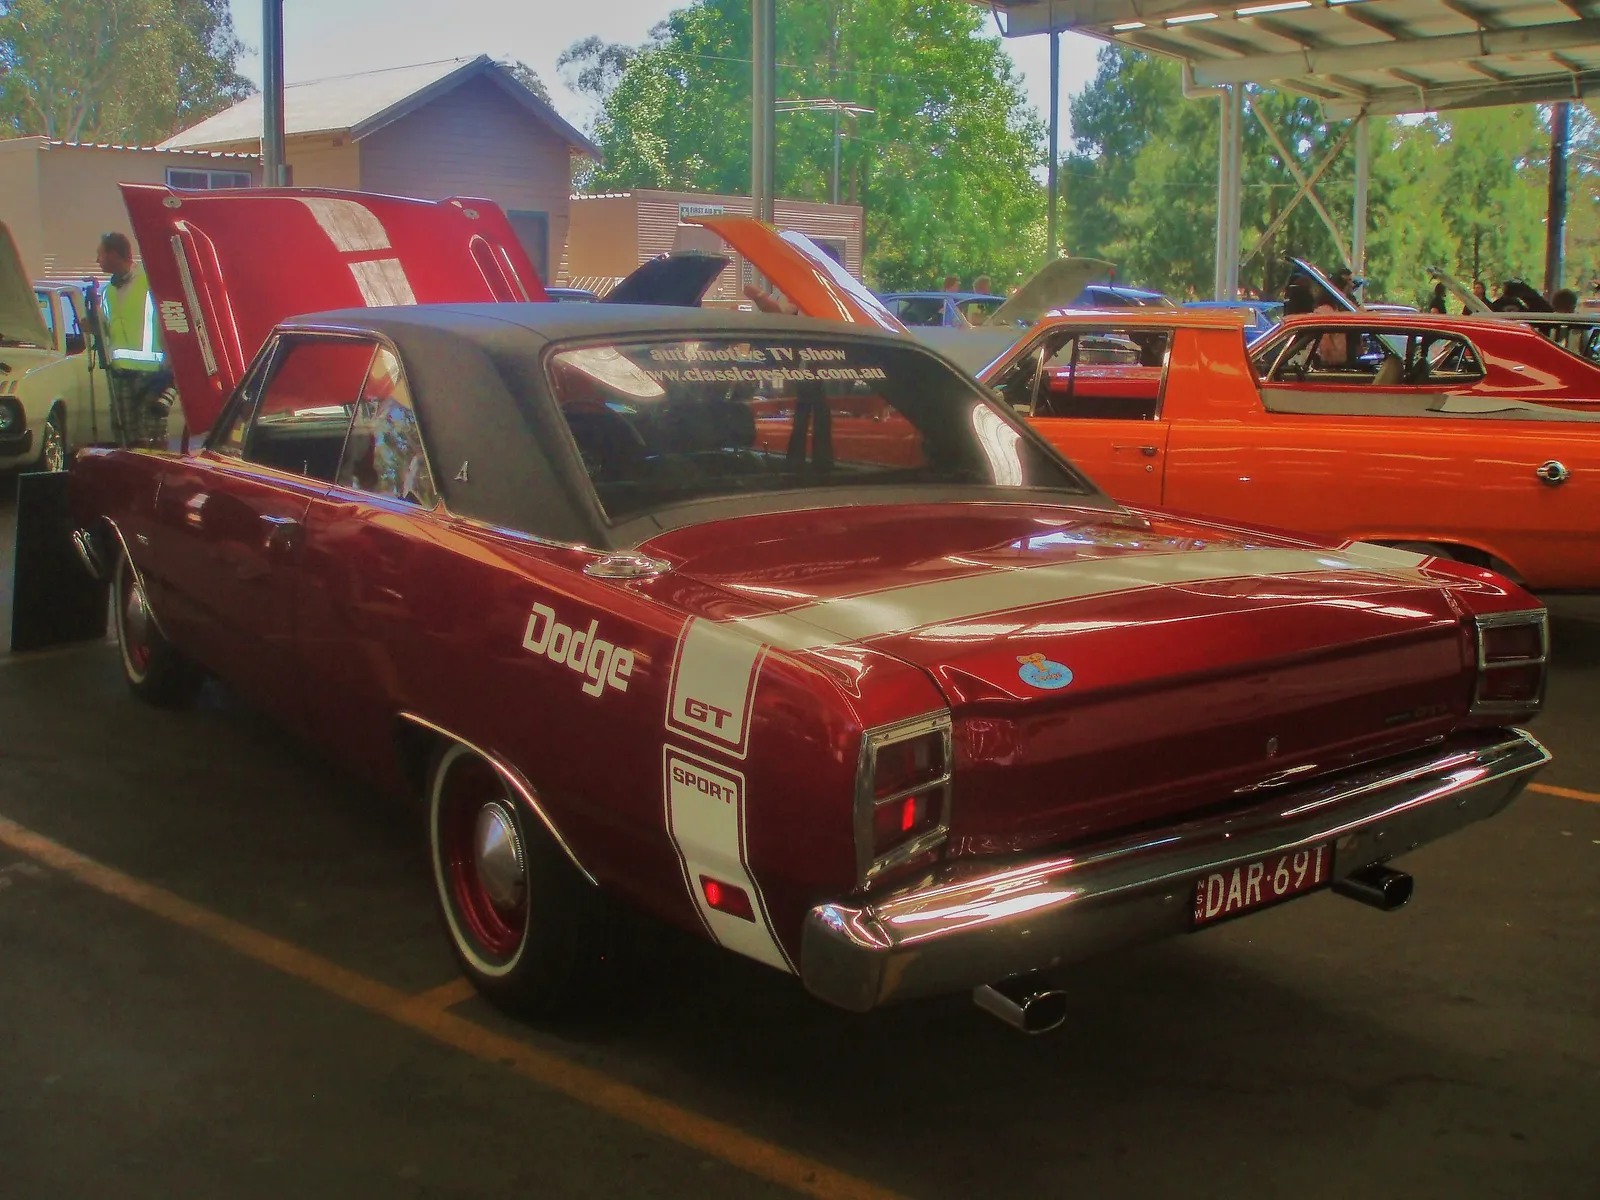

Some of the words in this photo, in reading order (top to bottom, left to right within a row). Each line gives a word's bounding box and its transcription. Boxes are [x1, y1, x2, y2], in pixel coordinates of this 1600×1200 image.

[690, 206, 704, 214] FIRST
[704, 207, 713, 215] AID
[766, 347, 796, 361] TV
[799, 347, 846, 361] show
[522, 601, 635, 698] Dodge
[684, 697, 732, 729] GT
[673, 766, 734, 804] SPORT
